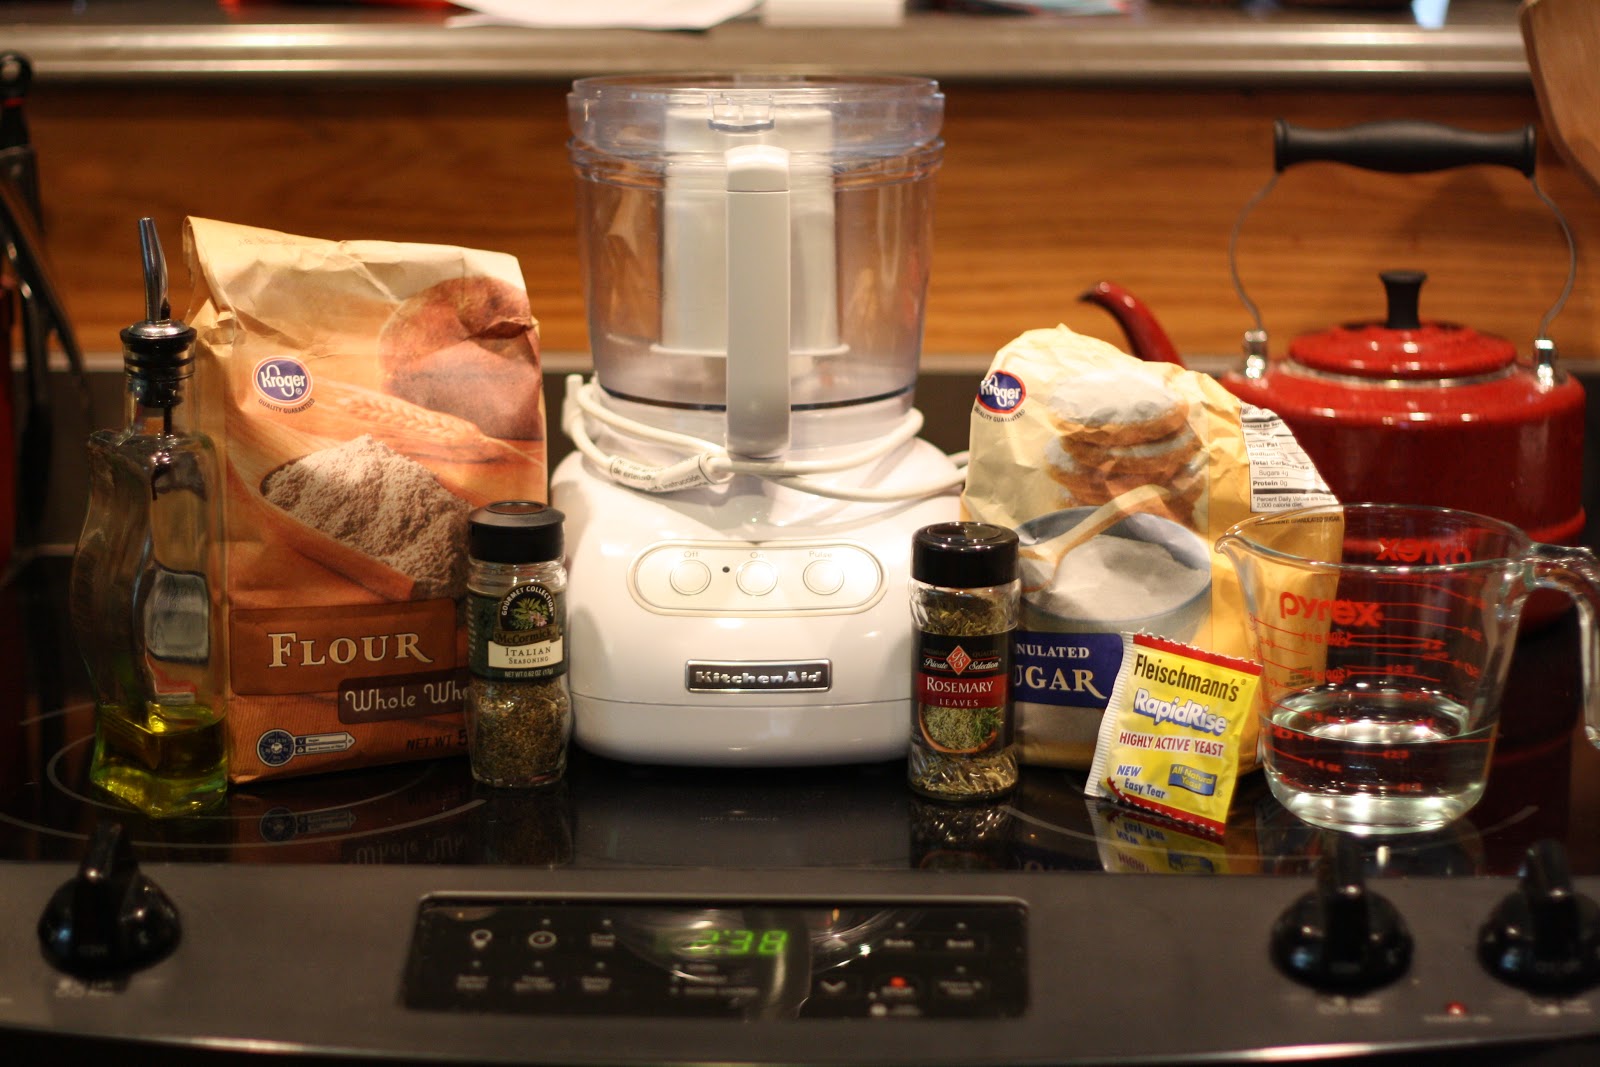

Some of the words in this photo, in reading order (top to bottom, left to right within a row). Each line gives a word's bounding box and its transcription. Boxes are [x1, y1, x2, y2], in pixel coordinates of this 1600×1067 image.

[261, 365, 305, 397] Kroger
[980, 374, 1021, 407] Kroger
[258, 398, 282, 413] QUALITY
[283, 398, 315, 414] GUARANTEED
[808, 550, 833, 558] Pulse
[501, 587, 525, 616] GOURMET
[526, 585, 554, 612] COLLECTION
[268, 632, 434, 668] FLOUR
[505, 646, 551, 657] ITALIAN
[1016, 643, 1090, 659] NULATED
[508, 655, 549, 665] SEASONING
[924, 658, 948, 669] Private
[968, 661, 999, 670] Selection
[696, 671, 821, 683] KitchenAid
[927, 677, 993, 693] ROSEMARY
[1015, 665, 1107, 699] UGAR
[1133, 654, 1239, 702] Fleischmann's
[345, 687, 416, 713] Whole
[940, 698, 979, 707] LEAVES
[1133, 687, 1227, 736] RapidRise
[1119, 732, 1153, 749] HIGHLY
[1154, 737, 1190, 752] ACTIVE
[1194, 740, 1224, 757] YEAST
[1117, 765, 1142, 777] NEW
[1172, 766, 1184, 775] All
[1184, 769, 1214, 785] Natural
[1124, 778, 1143, 795] Easy
[1147, 784, 1166, 799] Tear
